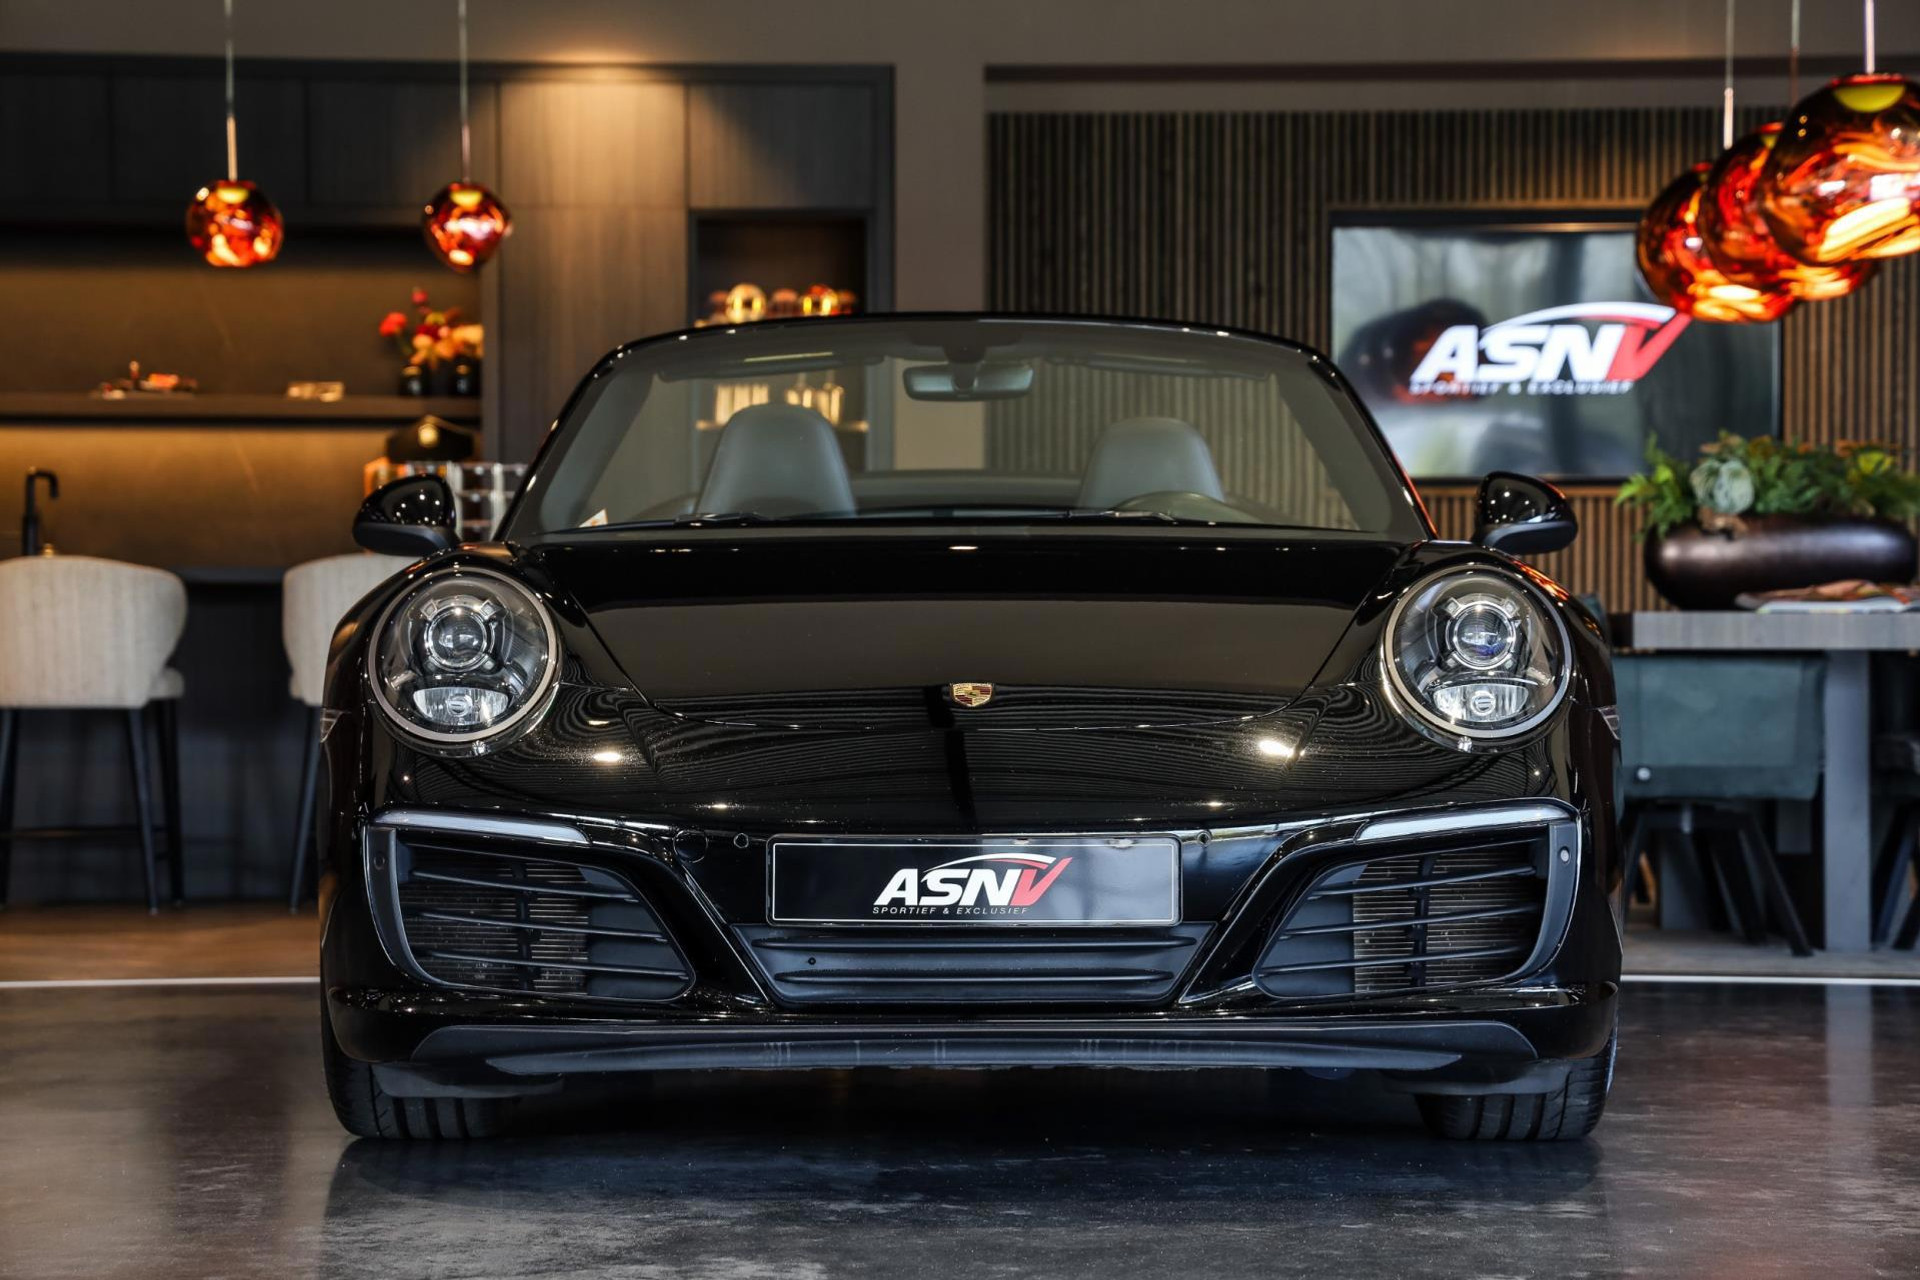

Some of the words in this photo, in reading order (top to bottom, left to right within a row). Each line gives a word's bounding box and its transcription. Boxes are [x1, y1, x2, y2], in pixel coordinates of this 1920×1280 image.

[872, 906, 937, 915] SPORTIEF
[942, 906, 950, 915] &
[956, 906, 1030, 915] EXCLUSIEF
